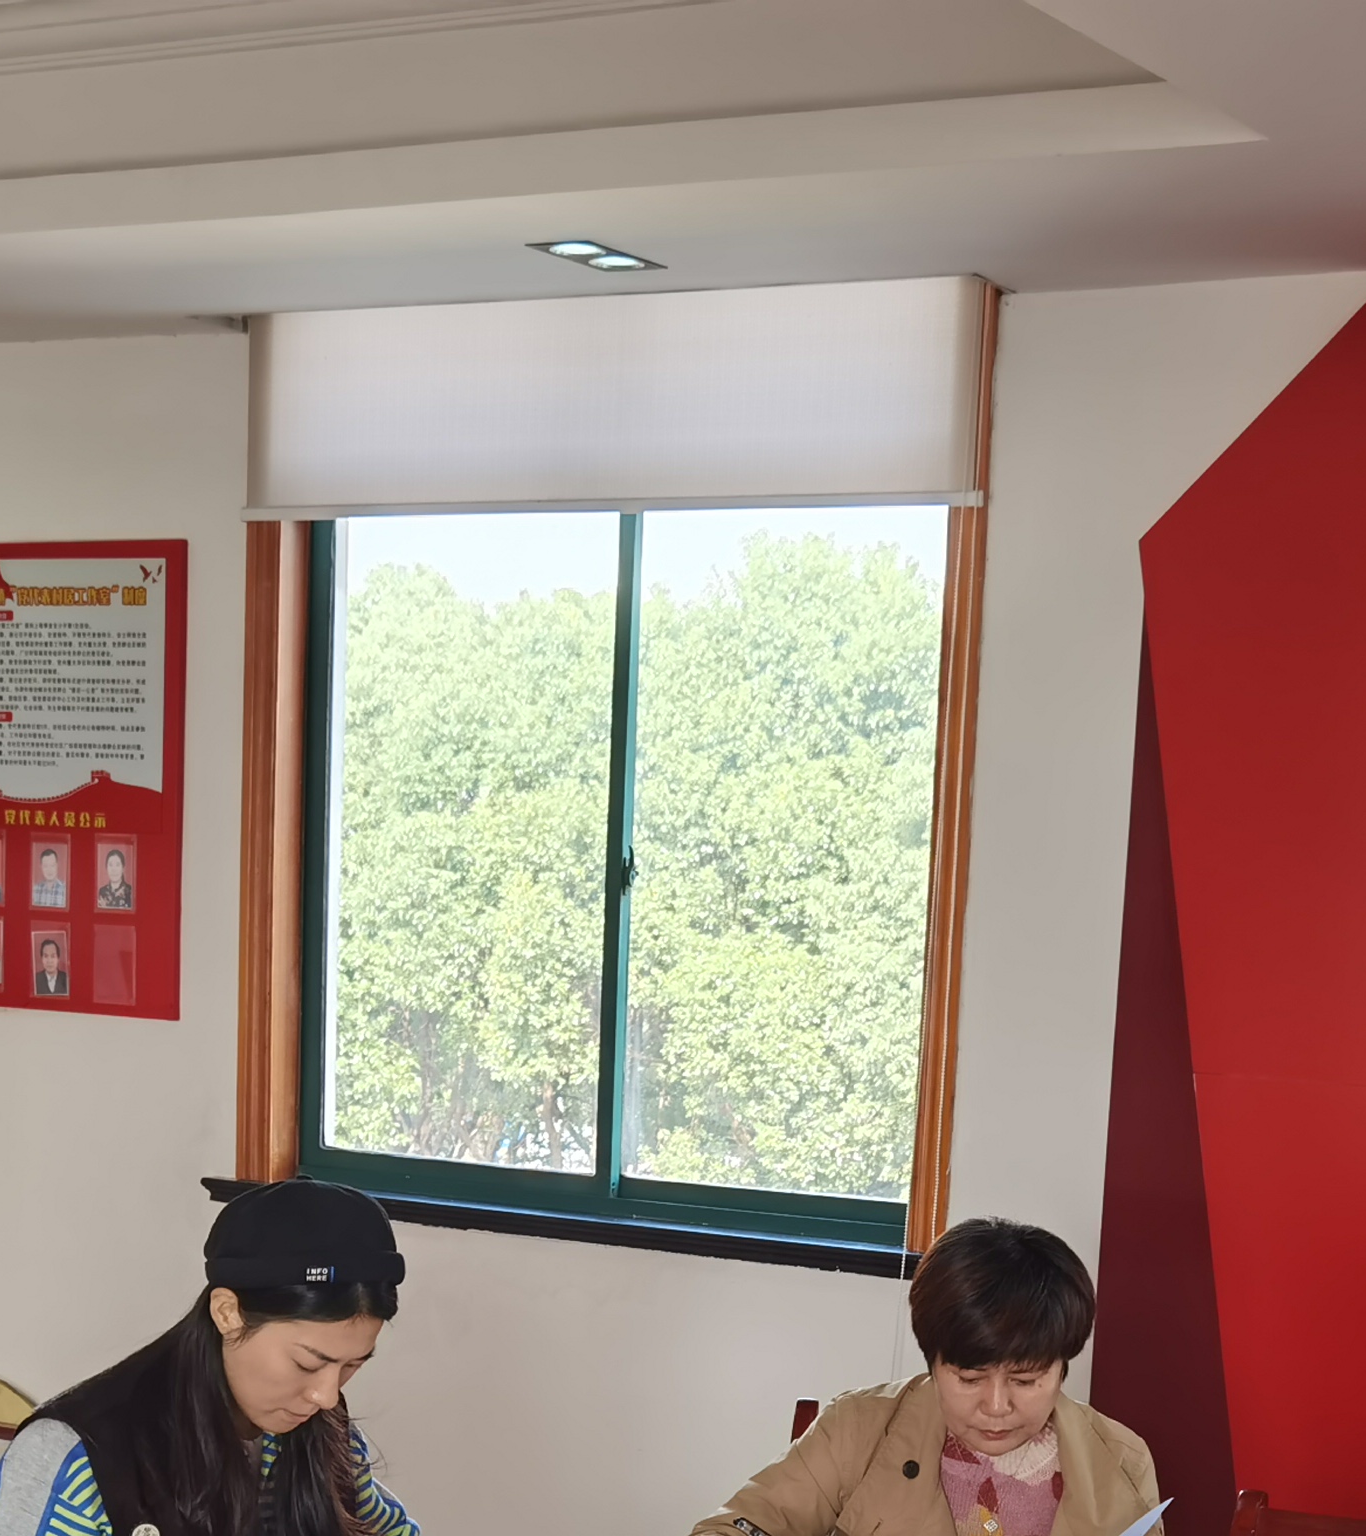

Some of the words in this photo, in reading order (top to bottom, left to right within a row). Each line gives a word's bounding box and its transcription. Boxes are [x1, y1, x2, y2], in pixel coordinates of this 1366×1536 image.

[4, 809, 108, 828] 党代表人员公示
[306, 1267, 329, 1275] INFO
[306, 1274, 328, 1282] HERE
